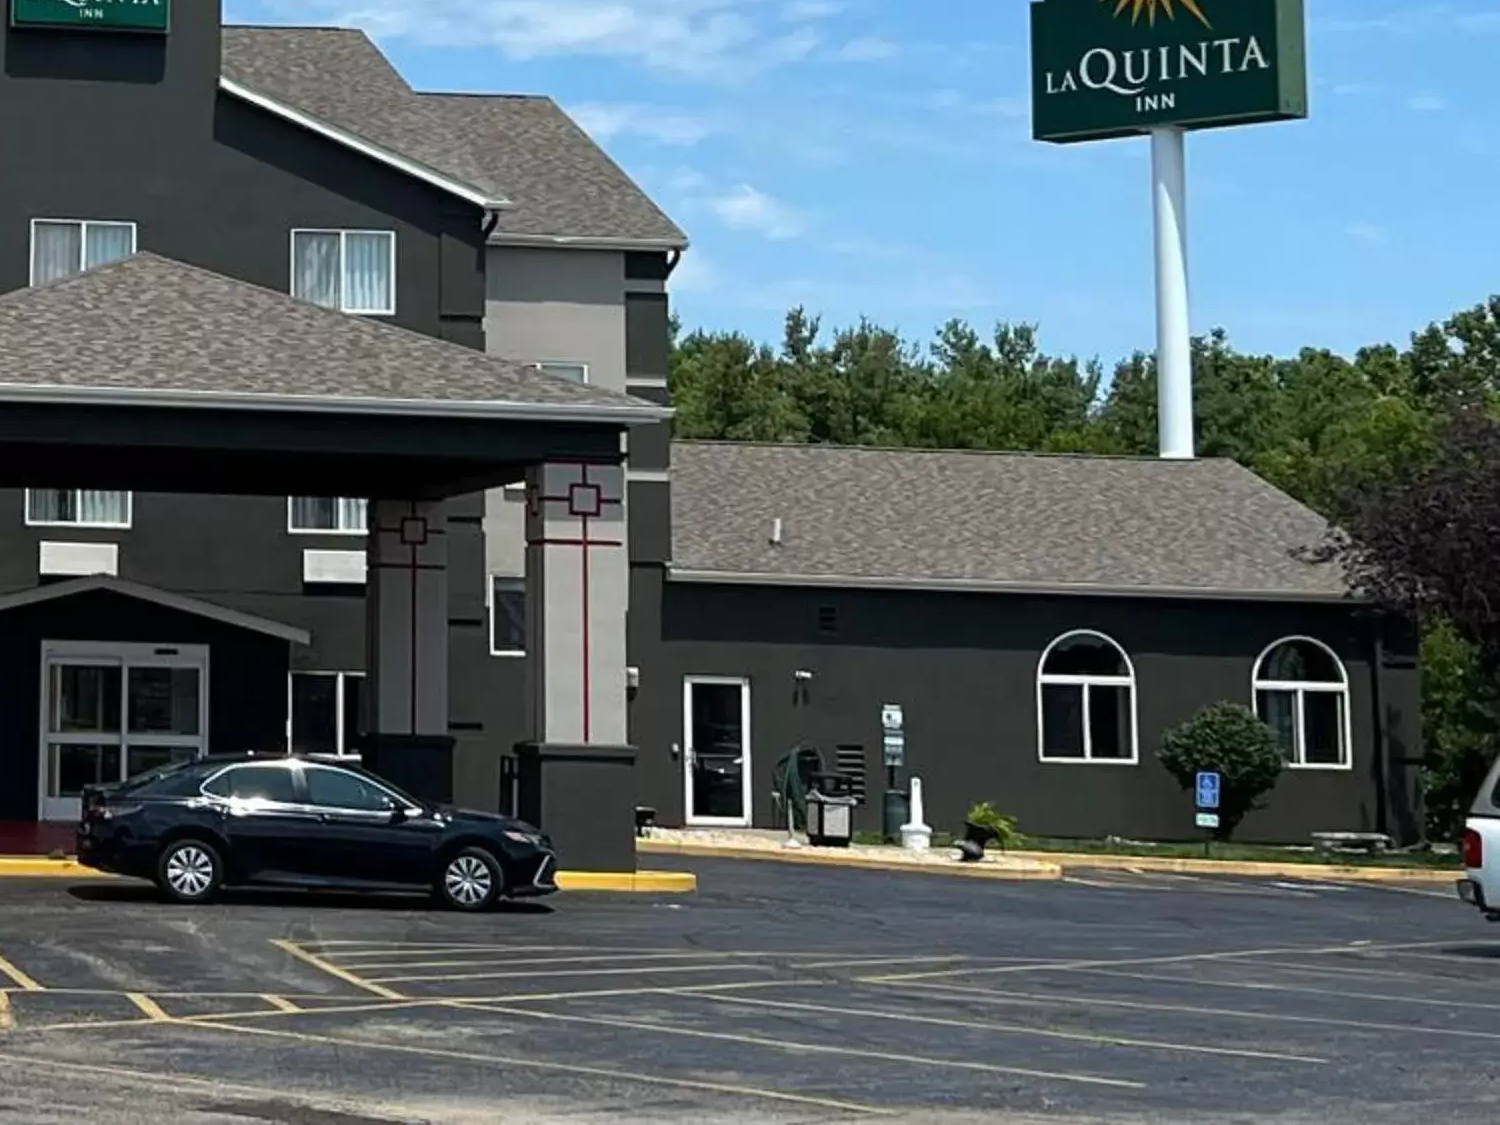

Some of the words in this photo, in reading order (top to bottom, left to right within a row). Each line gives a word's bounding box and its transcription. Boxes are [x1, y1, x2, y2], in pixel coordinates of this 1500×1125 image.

[79, 8, 104, 19] INN
[1045, 70, 1078, 94] LA
[1079, 35, 1270, 95] QUINTA
[1135, 92, 1176, 113] INN
